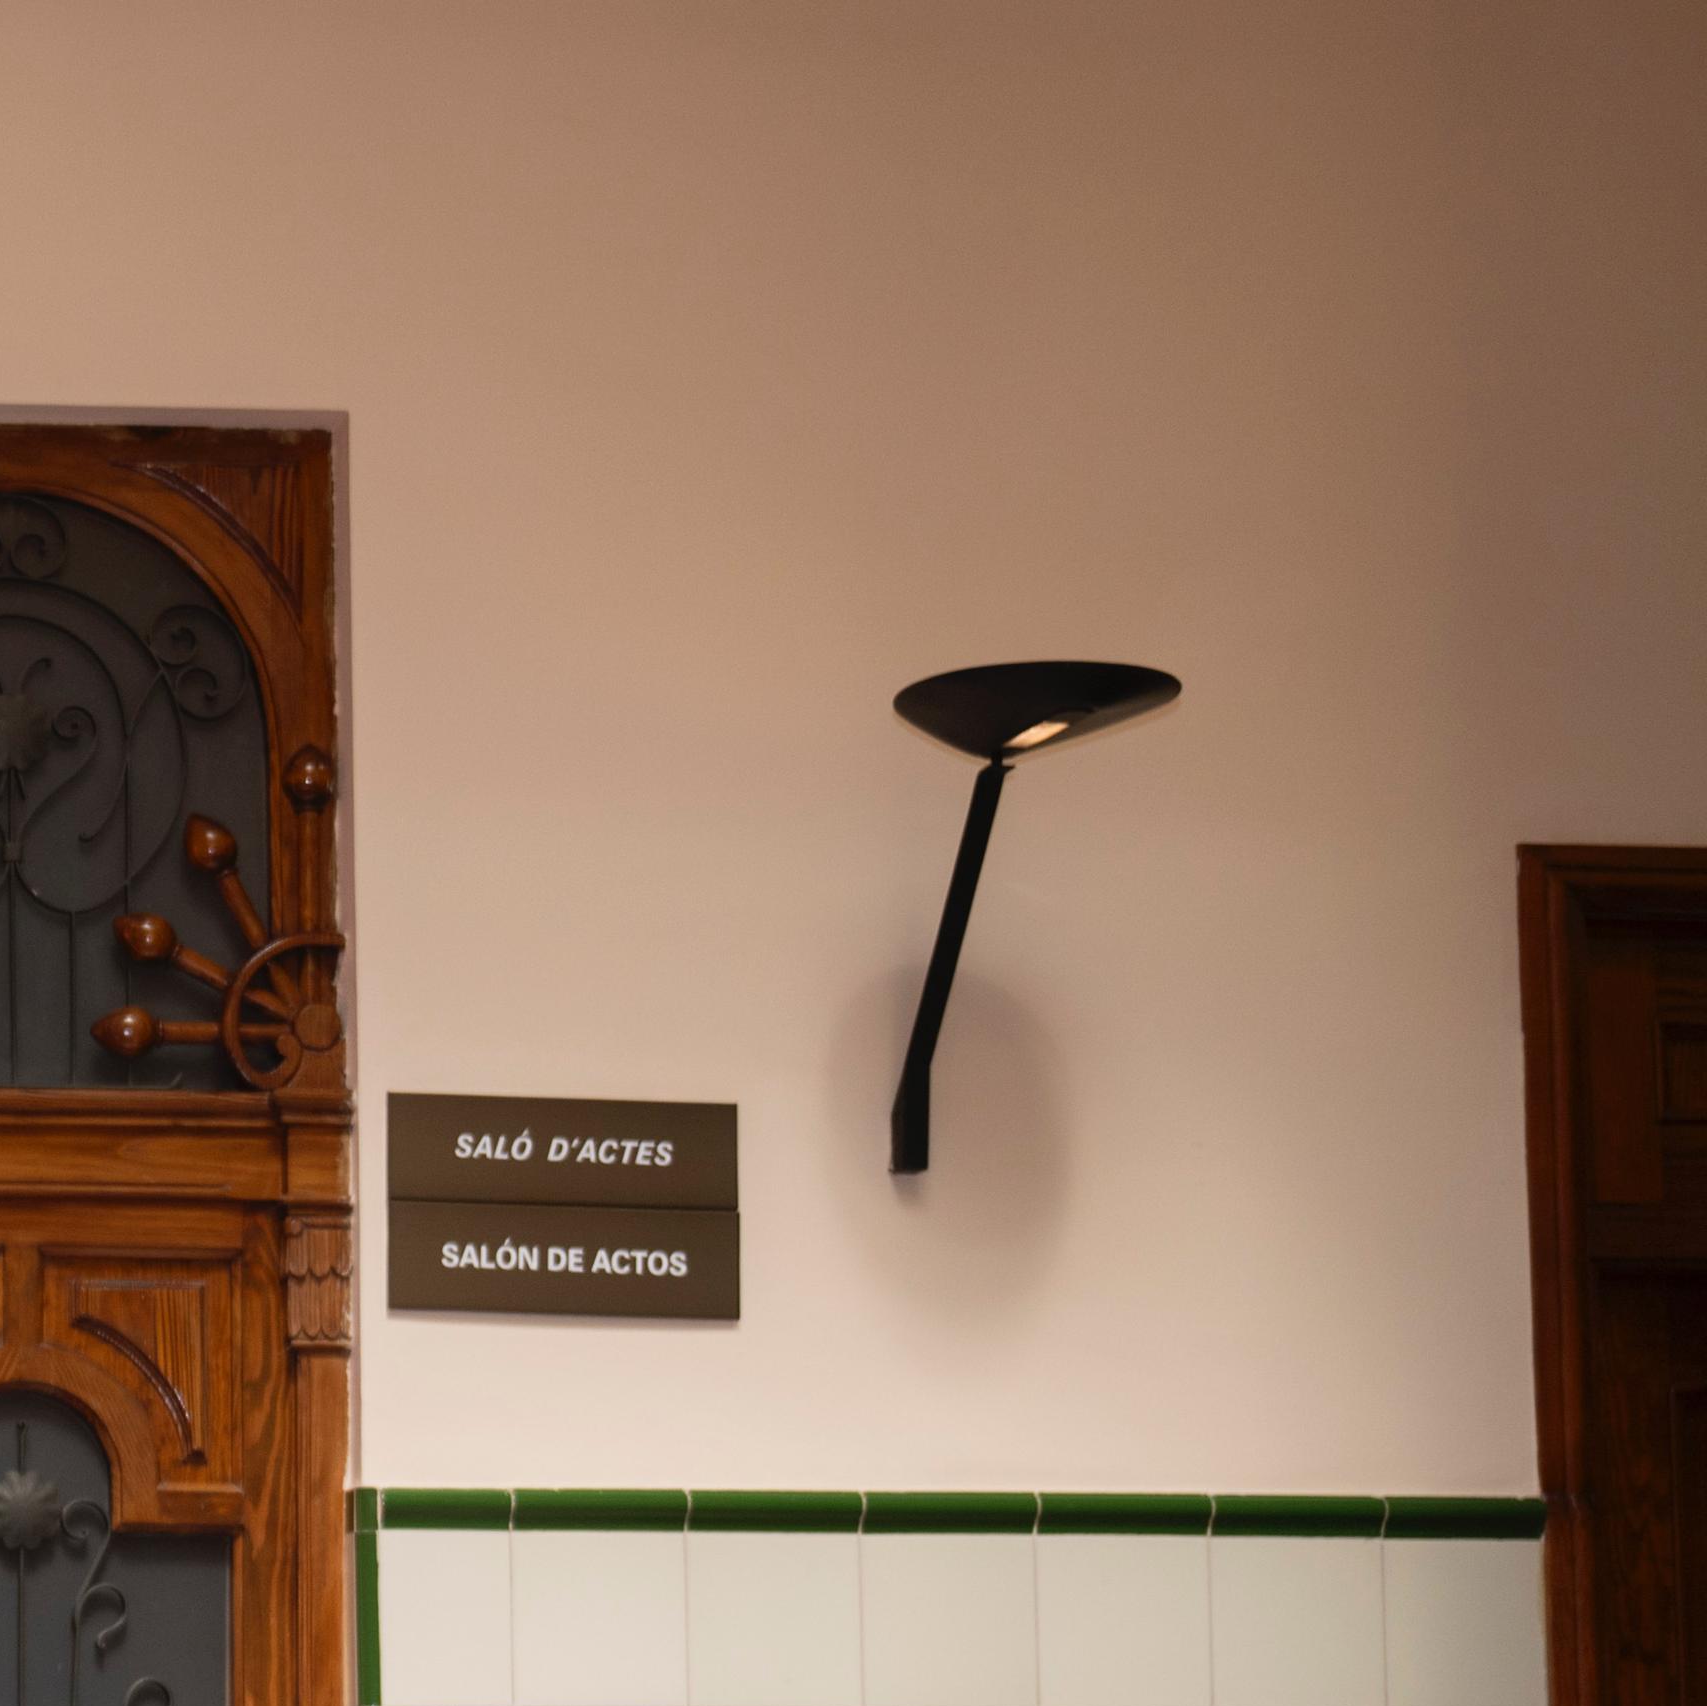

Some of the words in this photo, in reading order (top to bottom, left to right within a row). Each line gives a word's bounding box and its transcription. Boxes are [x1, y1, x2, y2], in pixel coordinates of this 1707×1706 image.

[454, 1128, 534, 1160] SALÓ
[547, 1137, 674, 1167] D'ACTES
[441, 1237, 539, 1272] SALÓN
[547, 1248, 585, 1273] DE
[591, 1249, 688, 1277] ACTOS
